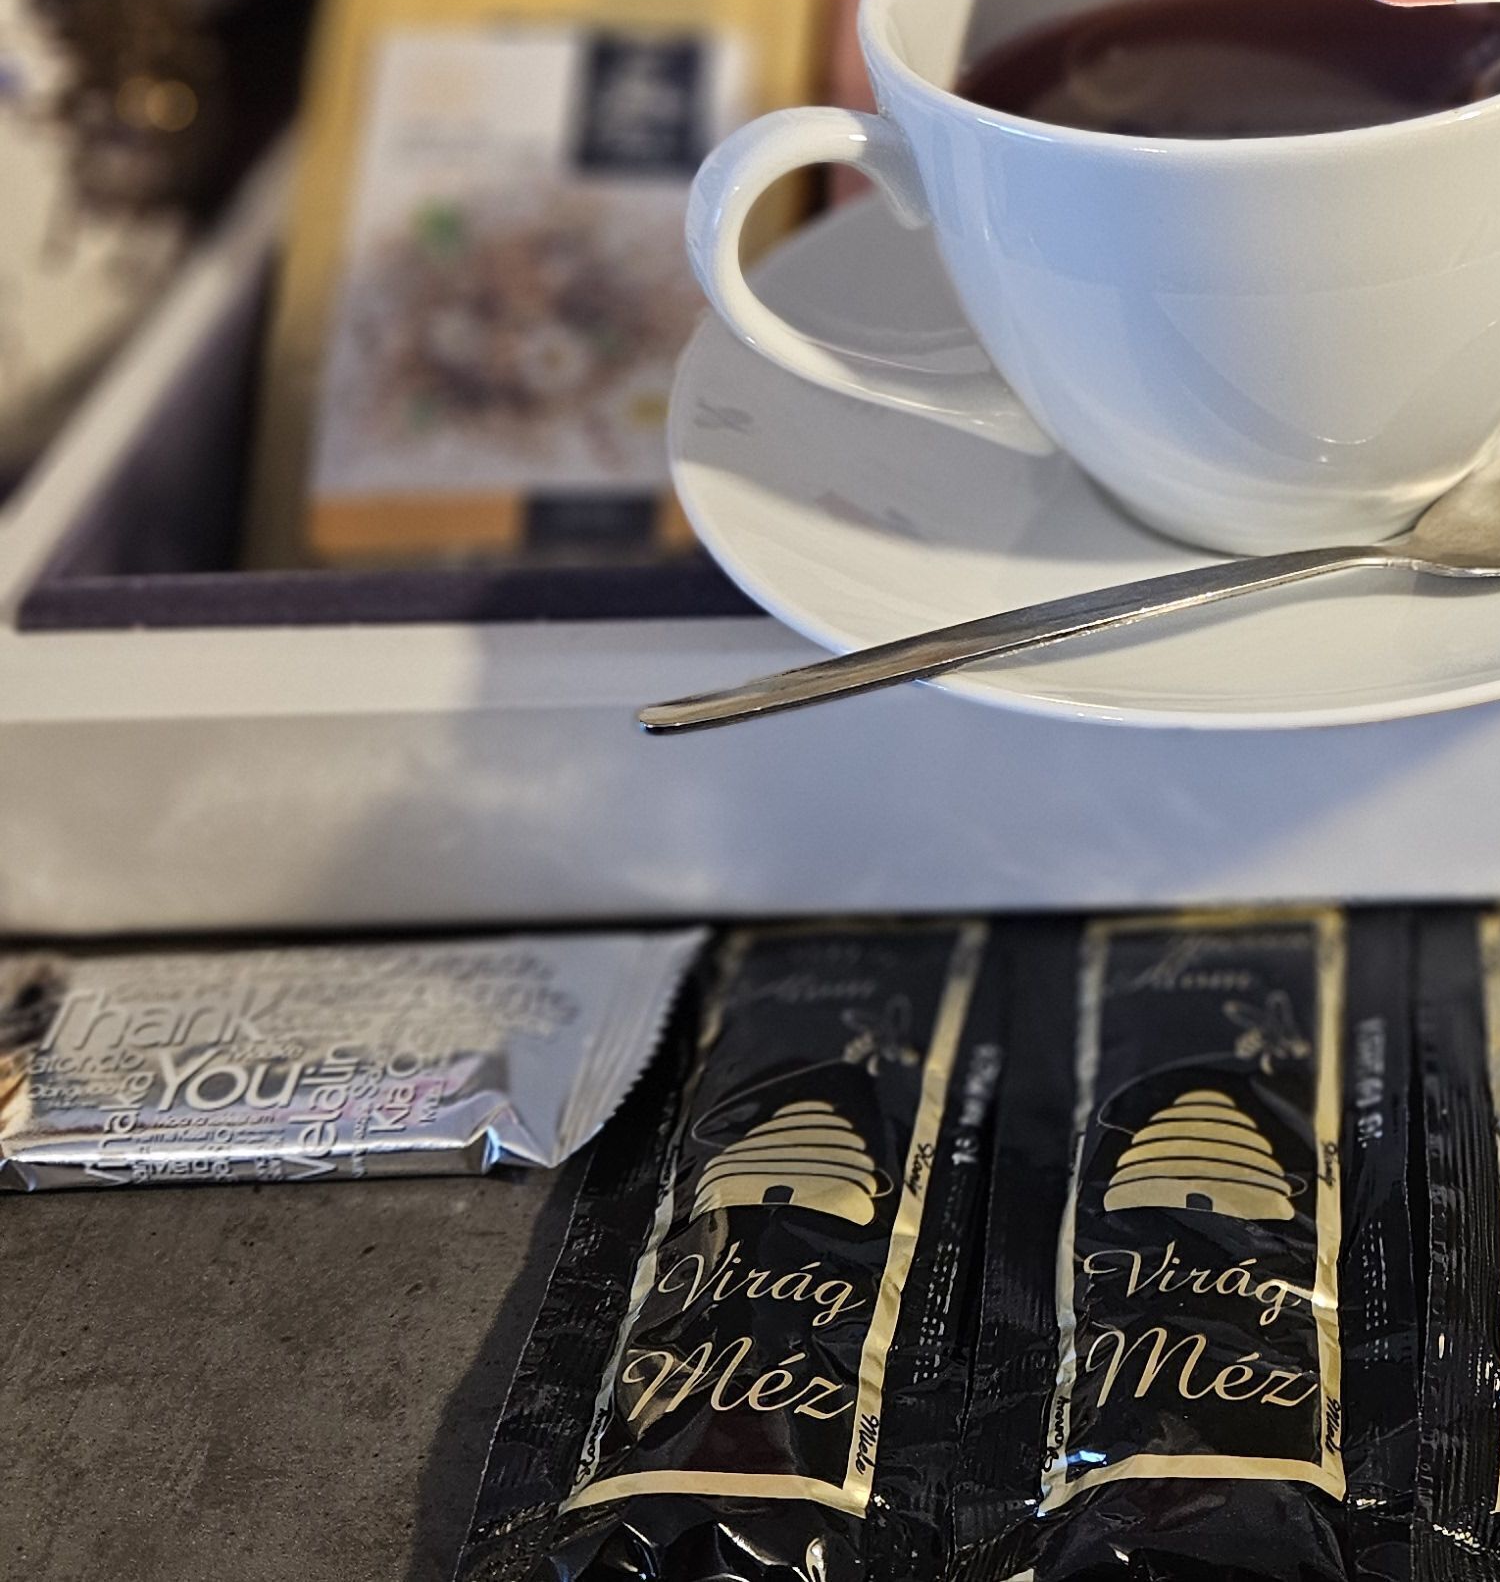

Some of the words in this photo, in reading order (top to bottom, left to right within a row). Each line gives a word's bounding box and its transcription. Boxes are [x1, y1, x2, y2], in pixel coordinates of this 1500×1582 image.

[40, 975, 288, 1052] Thank
[158, 1048, 304, 1113] You
[658, 1241, 866, 1326] Virág
[1083, 1241, 1306, 1325] Virág
[622, 1337, 856, 1422] Méz
[1085, 1327, 1318, 1409] Méz
[854, 1414, 882, 1476] Miele
[1041, 1397, 1071, 1474] Honey
[1325, 1397, 1343, 1455] Miele
